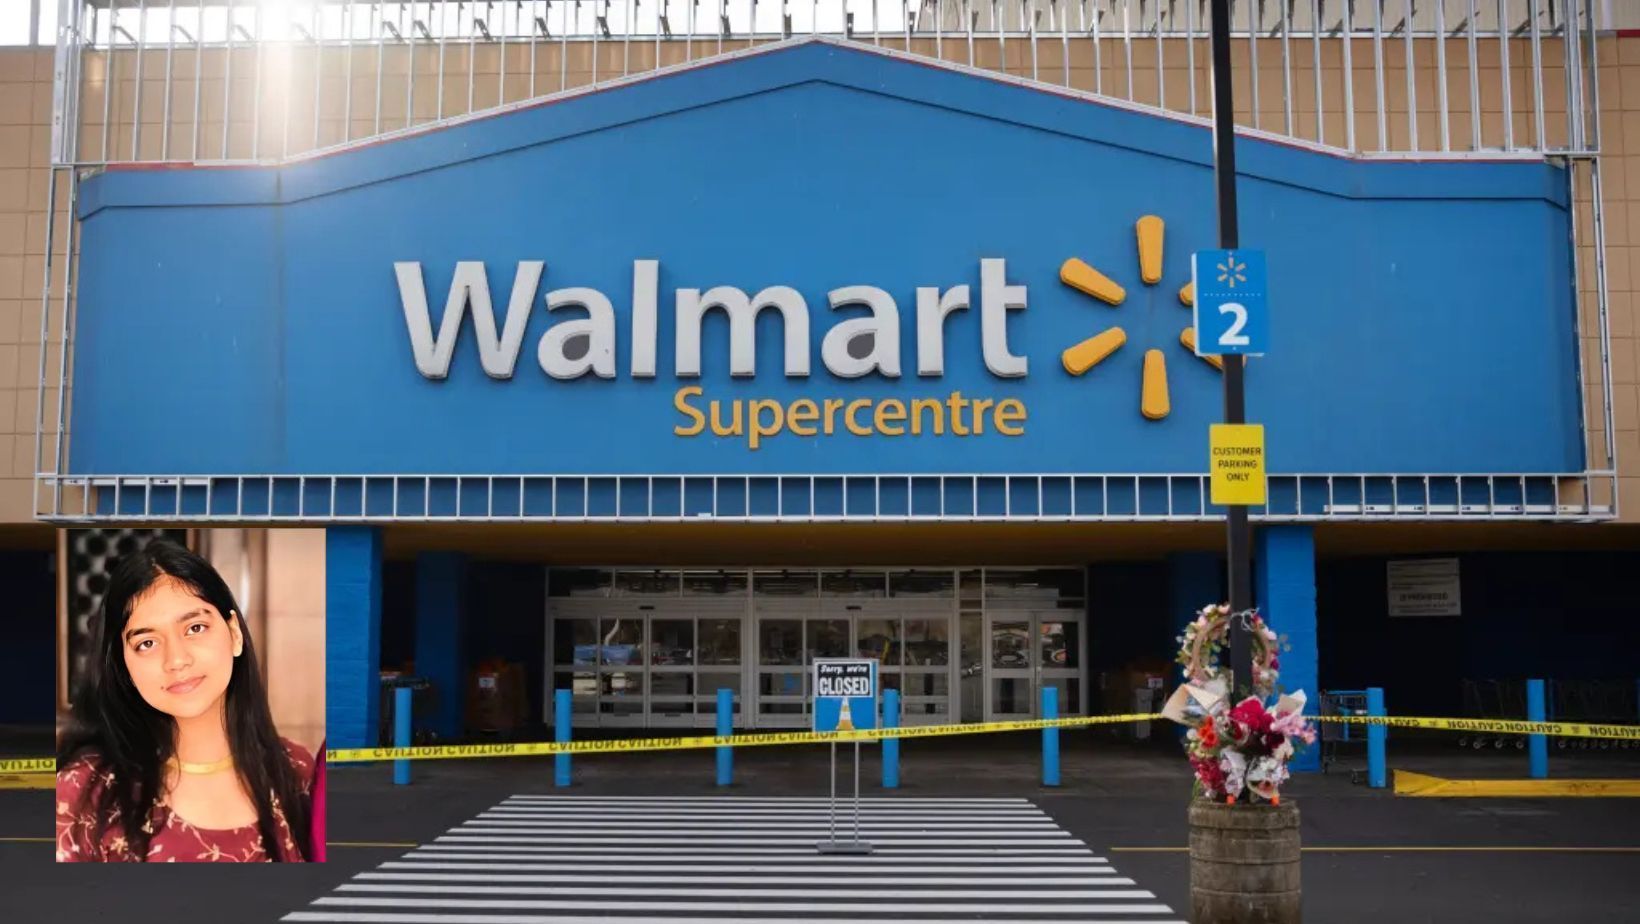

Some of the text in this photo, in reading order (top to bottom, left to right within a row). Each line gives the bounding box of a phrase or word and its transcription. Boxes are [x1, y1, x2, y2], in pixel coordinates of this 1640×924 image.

[393, 257, 1028, 380] Walmart
[1218, 302, 1250, 345] 2
[673, 385, 1027, 449] Supercentre
[1213, 446, 1262, 456] CUSTOMER
[1218, 459, 1258, 469] PARKING
[1226, 472, 1250, 481] ONLY
[819, 676, 869, 695] CLOSED
[1447, 720, 1504, 731] CAUTION
[1505, 721, 1562, 734] CAUTION
[1589, 726, 1640, 737] AUTION
